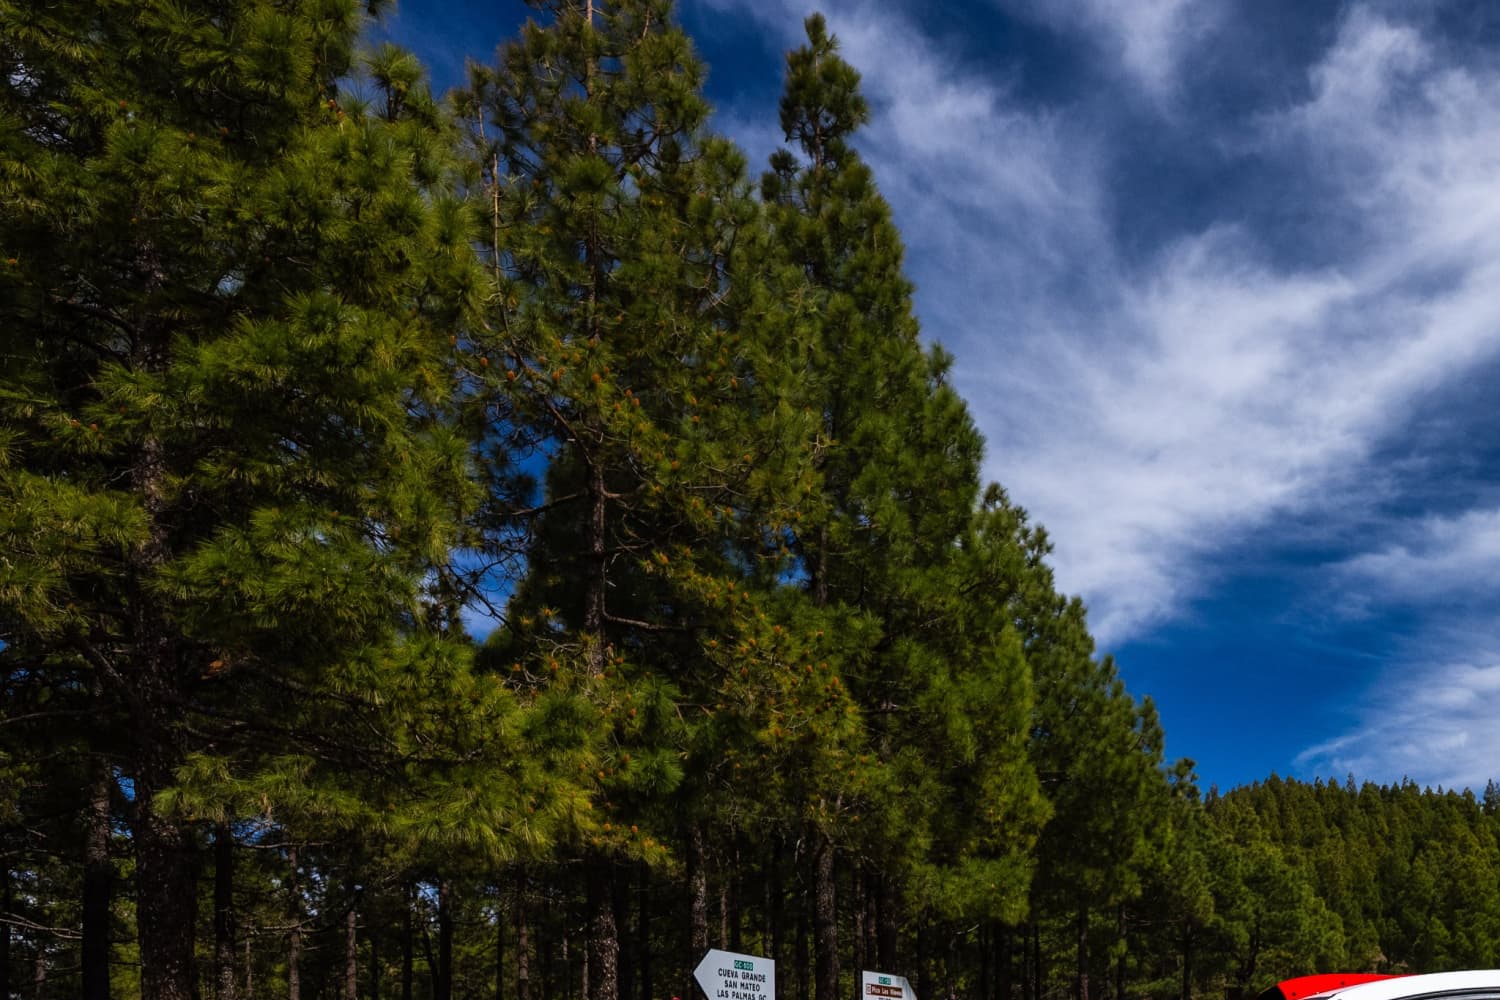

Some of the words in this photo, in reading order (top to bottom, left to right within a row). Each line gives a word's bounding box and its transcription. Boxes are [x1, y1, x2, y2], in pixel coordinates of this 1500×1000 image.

[718, 968, 739, 979] CUEVA
[742, 972, 767, 983] GRANDE
[724, 980, 738, 989] SAN
[740, 982, 761, 992] MATEO
[717, 990, 729, 998] LAS
[732, 991, 756, 1000] PALMAS
